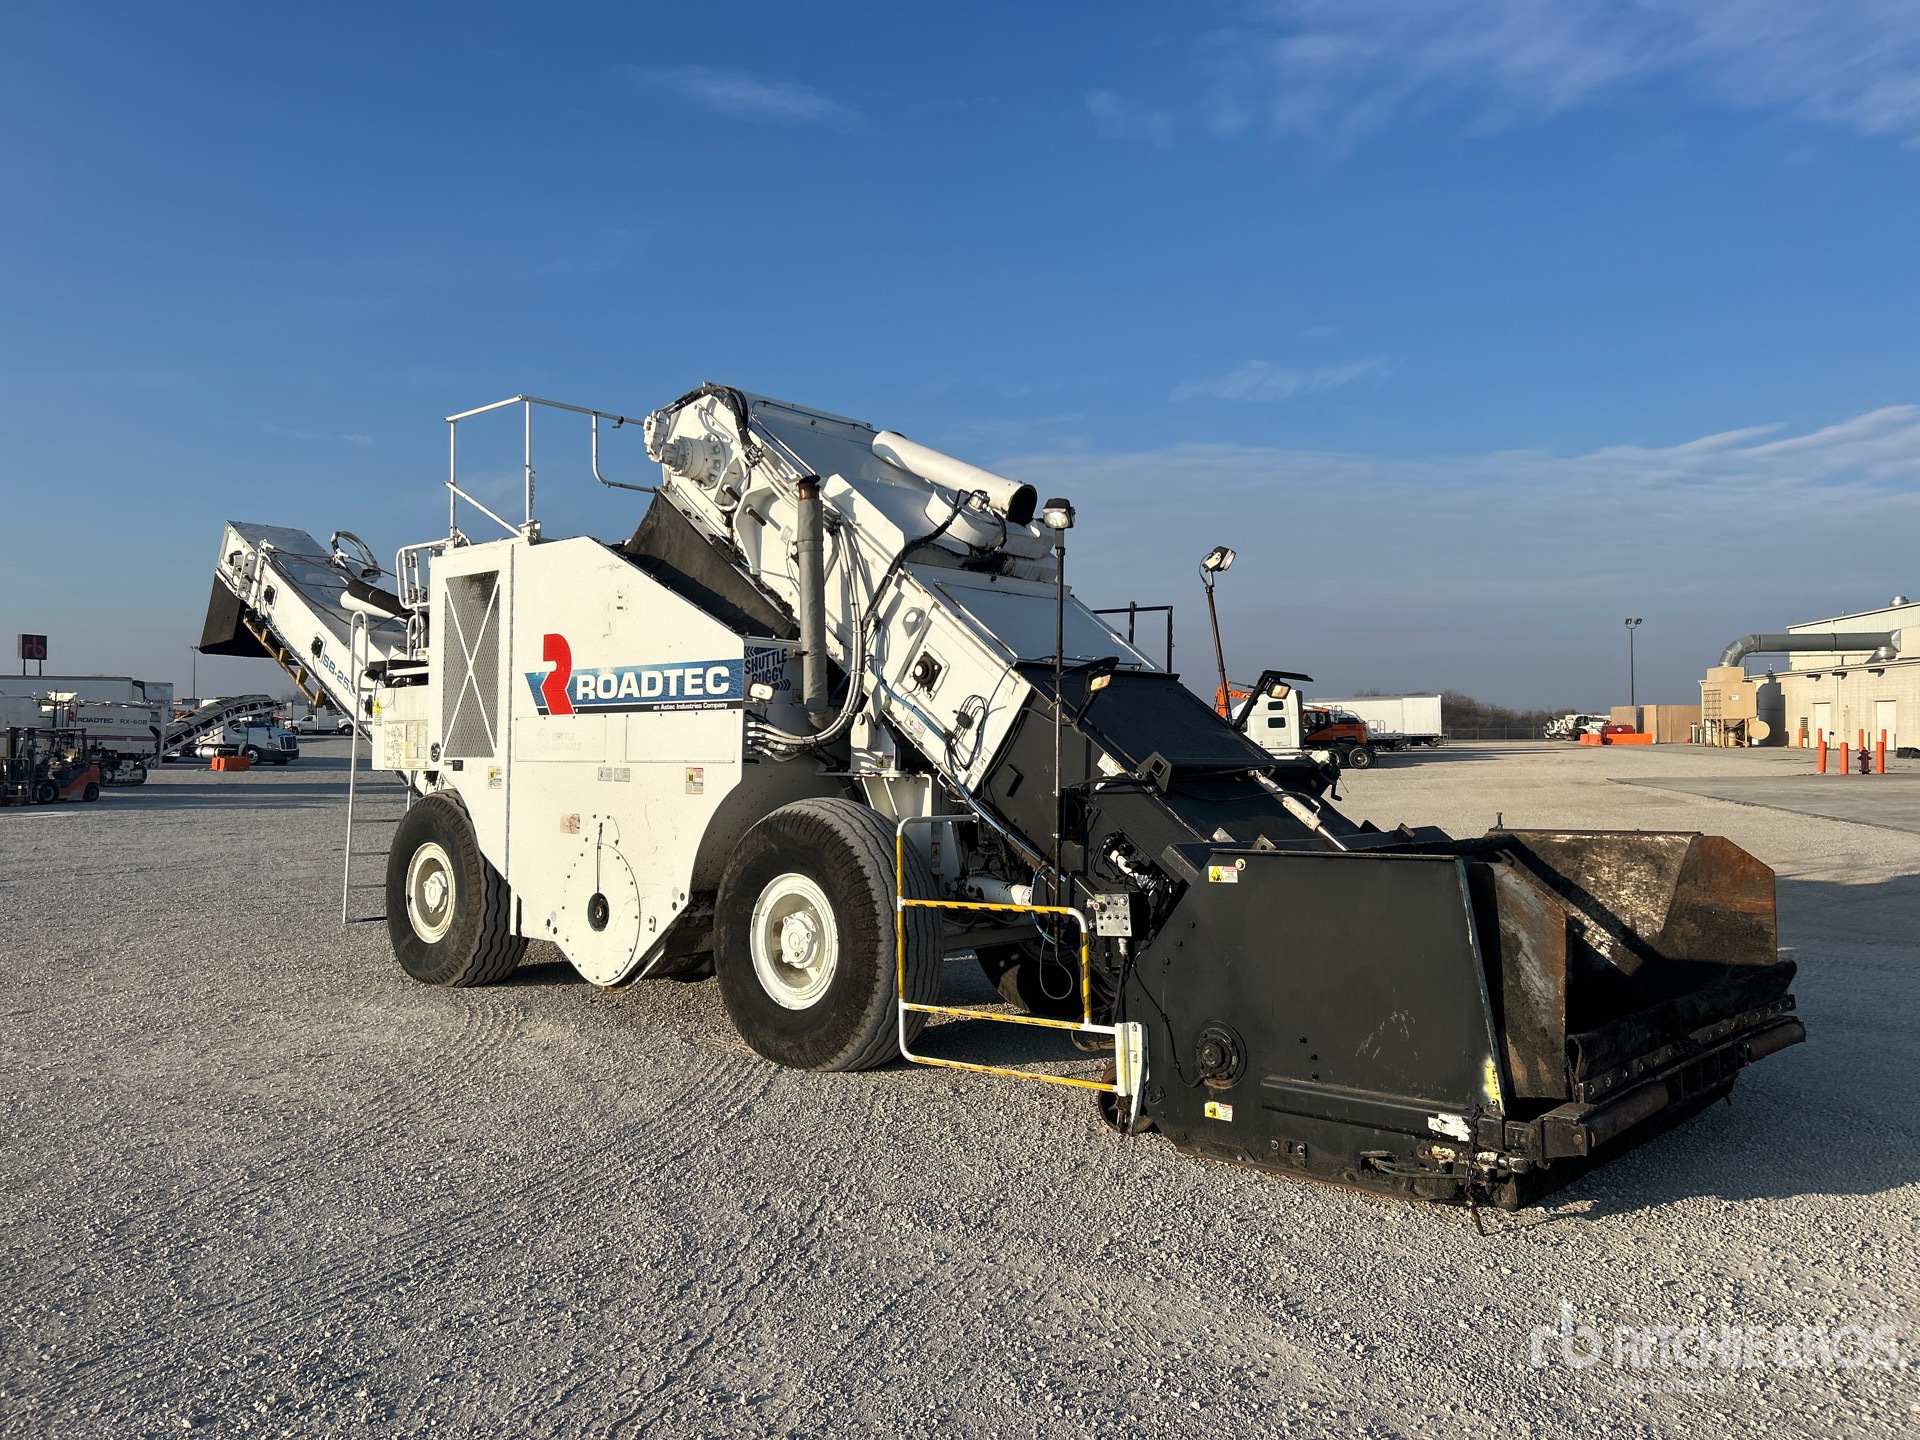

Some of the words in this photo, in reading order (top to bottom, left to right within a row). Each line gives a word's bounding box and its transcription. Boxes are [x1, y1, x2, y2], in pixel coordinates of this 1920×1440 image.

[24, 635, 45, 658] rb
[745, 648, 788, 675] SHUTTLE
[576, 666, 730, 700] ROADTEC
[120, 718, 148, 726] RX-60B
